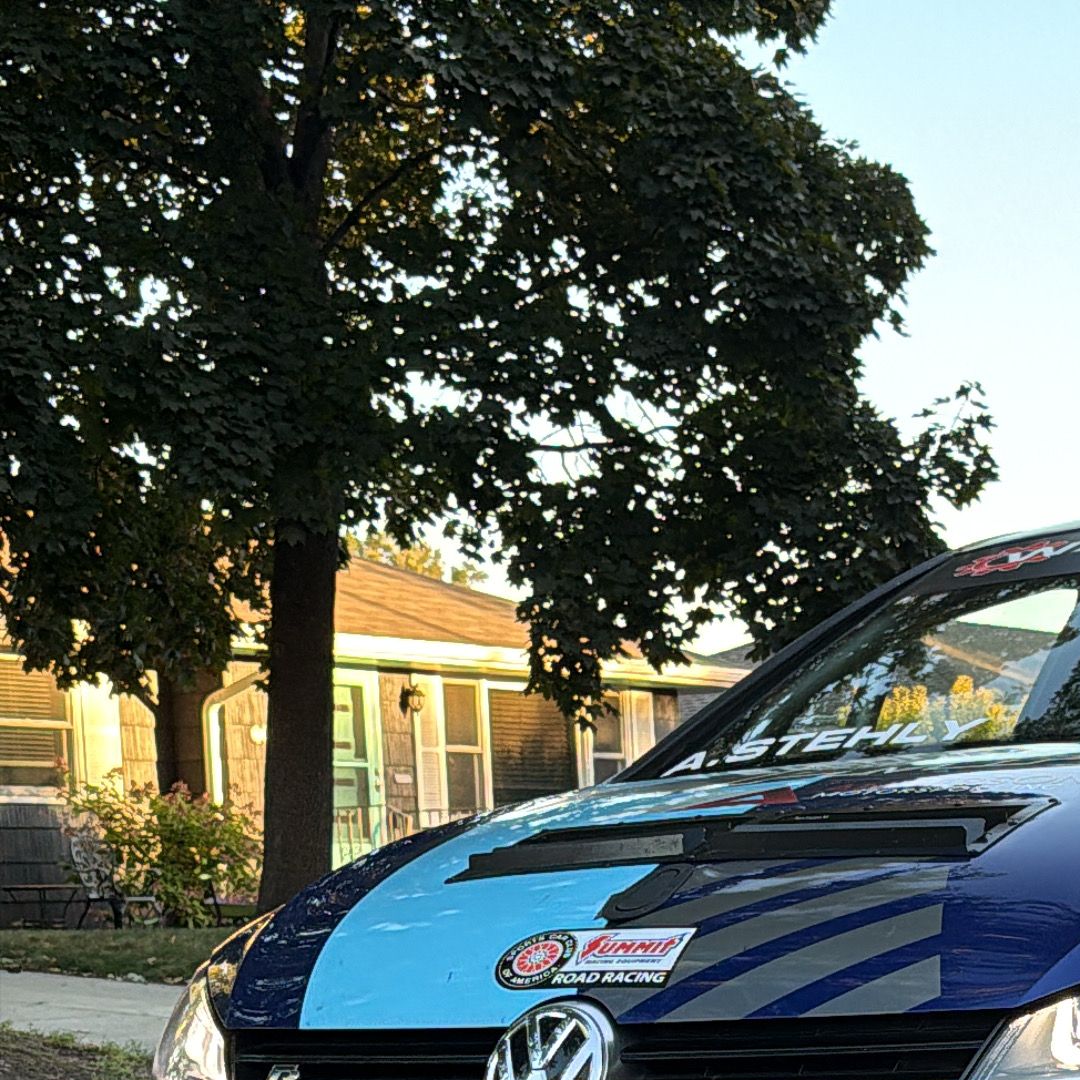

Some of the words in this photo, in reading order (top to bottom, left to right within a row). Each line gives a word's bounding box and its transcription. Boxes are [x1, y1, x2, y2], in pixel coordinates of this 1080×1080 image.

[660, 717, 989, 778] A.STEHLY
[579, 933, 680, 960] SUMMIT
[551, 972, 600, 985] ROAD
[602, 971, 666, 984] RACING
